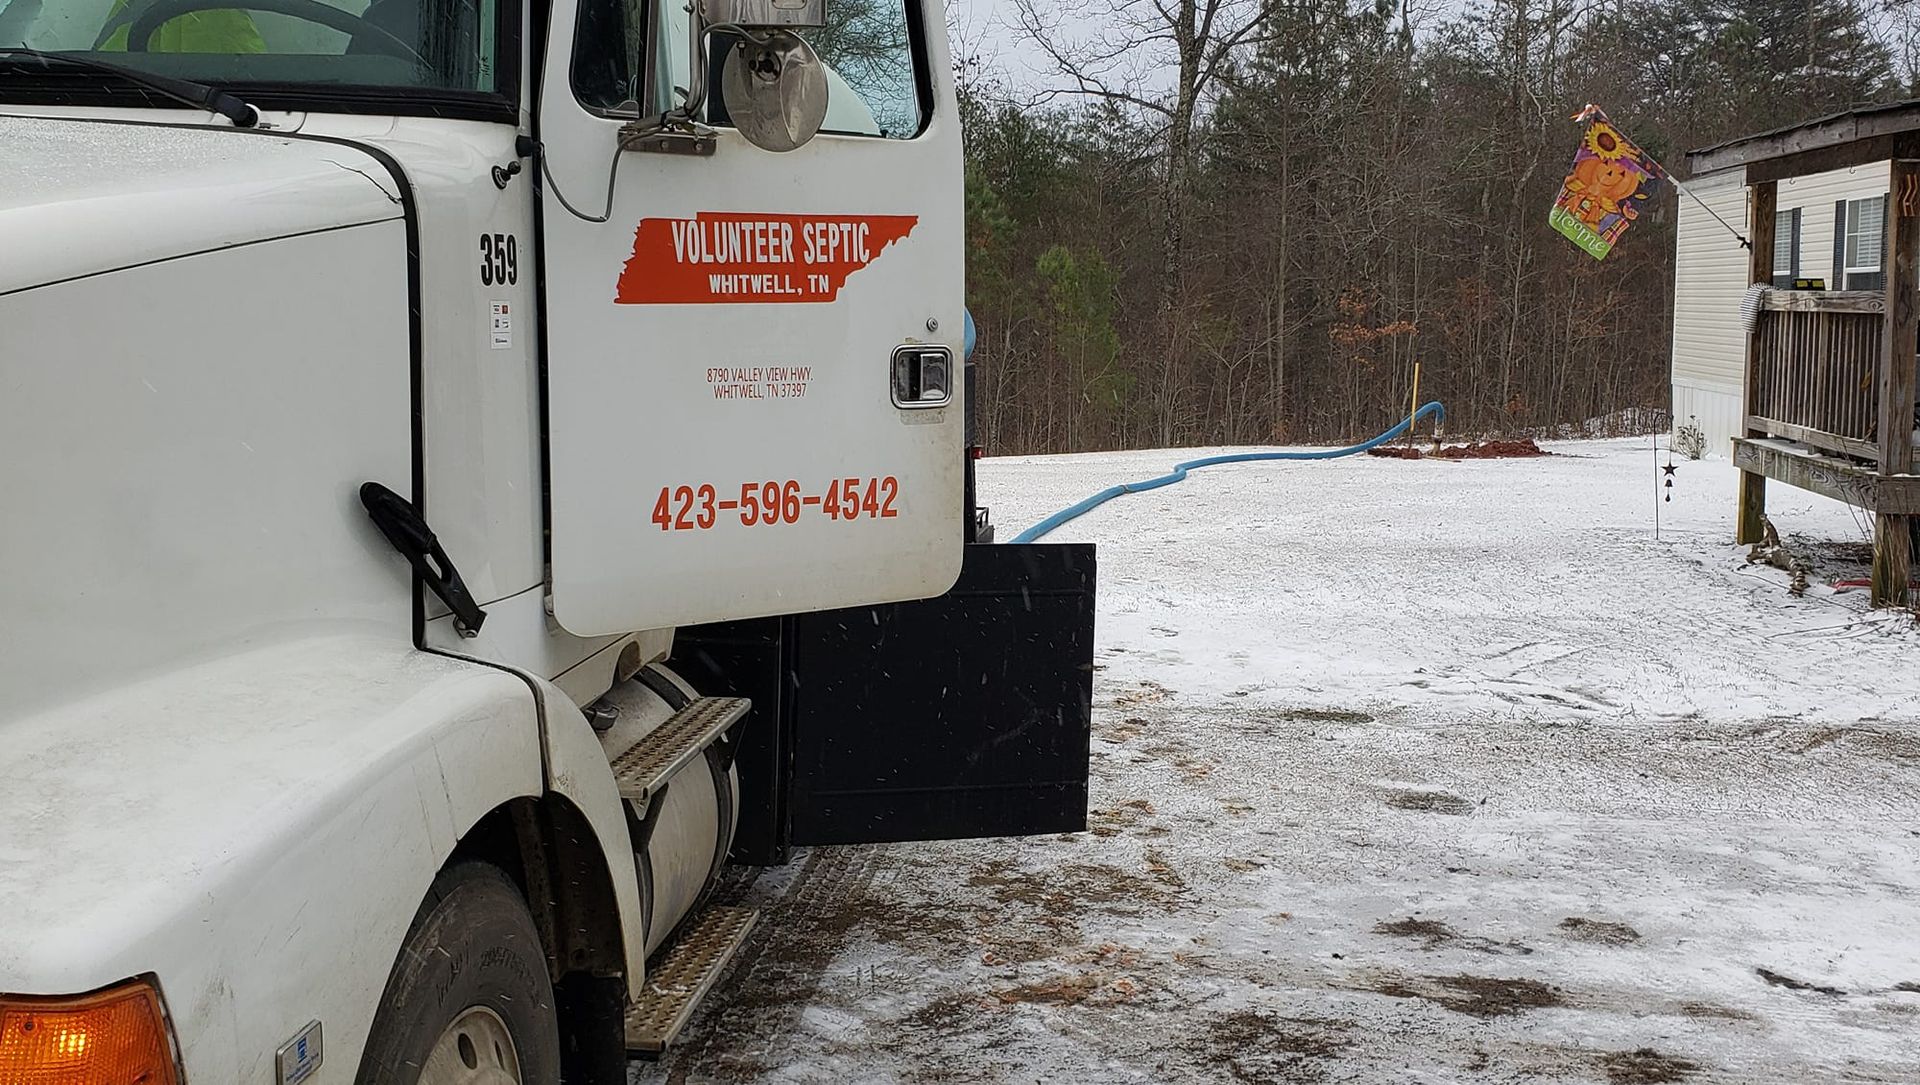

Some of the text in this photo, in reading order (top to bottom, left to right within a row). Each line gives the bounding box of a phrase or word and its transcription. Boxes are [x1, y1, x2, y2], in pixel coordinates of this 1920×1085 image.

[671, 220, 870, 265] VOLUNTEER SEPTIC
[1550, 205, 1605, 251] elcome
[480, 233, 518, 287] 359
[709, 274, 829, 296] WHITWELL, TN
[707, 366, 814, 382] 8790 VALLEY VIEW HWY.
[714, 383, 807, 400] WHITWELL, TN 37397
[651, 476, 898, 531] 423-596-4542
